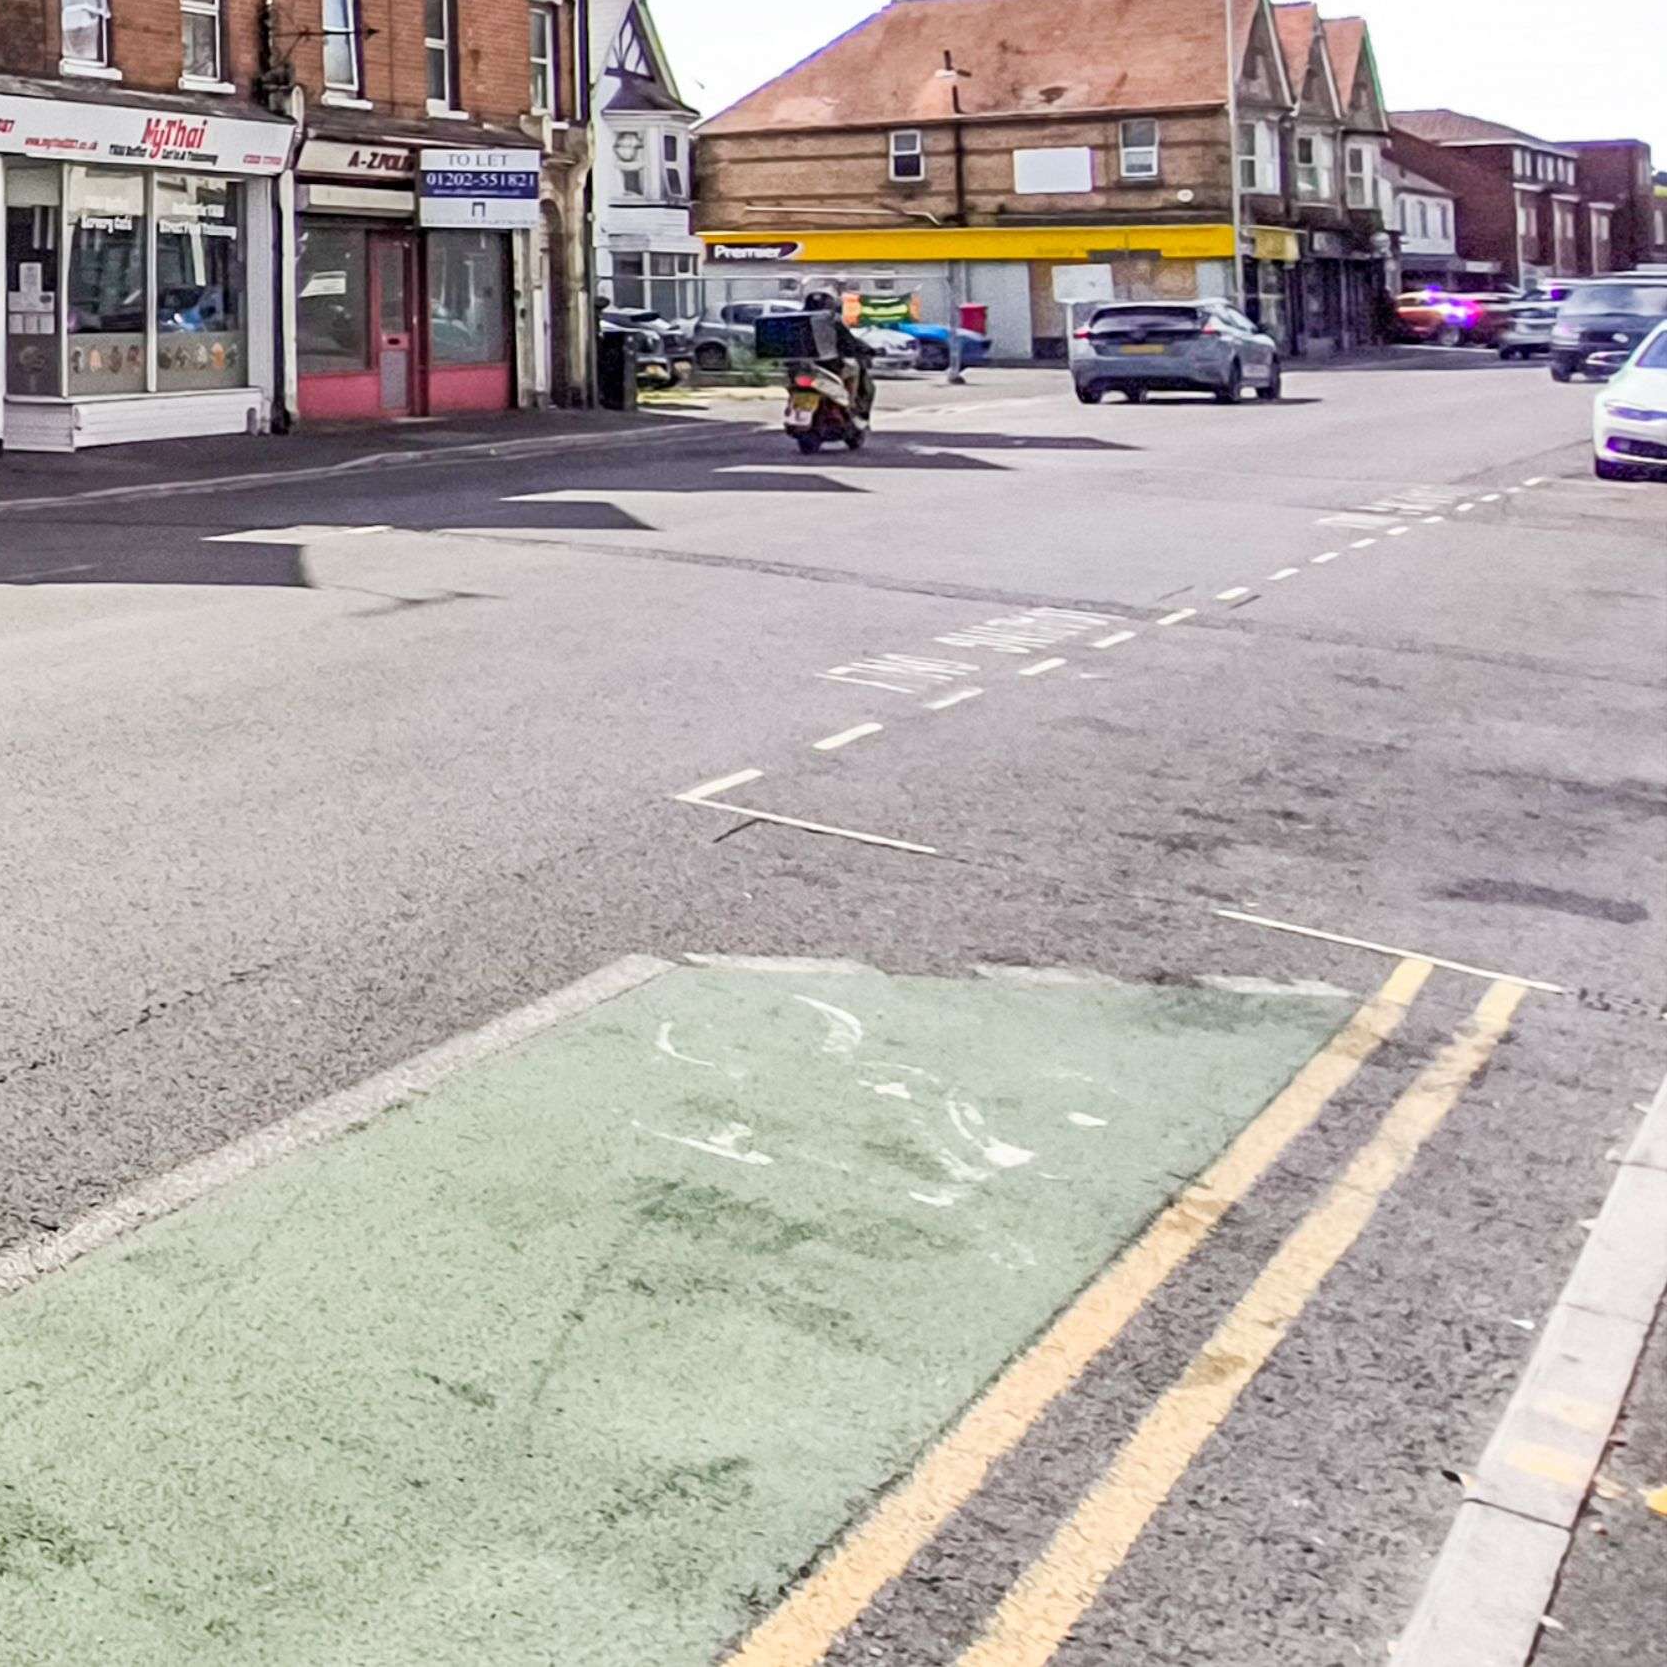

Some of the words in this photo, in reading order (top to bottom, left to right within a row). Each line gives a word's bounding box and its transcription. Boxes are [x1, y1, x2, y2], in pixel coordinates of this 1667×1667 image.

[141, 117, 208, 159] MyThai
[446, 153, 470, 168] TO
[476, 153, 510, 168] LET
[426, 172, 535, 187] 01202-551821
[714, 244, 782, 259] Premier
